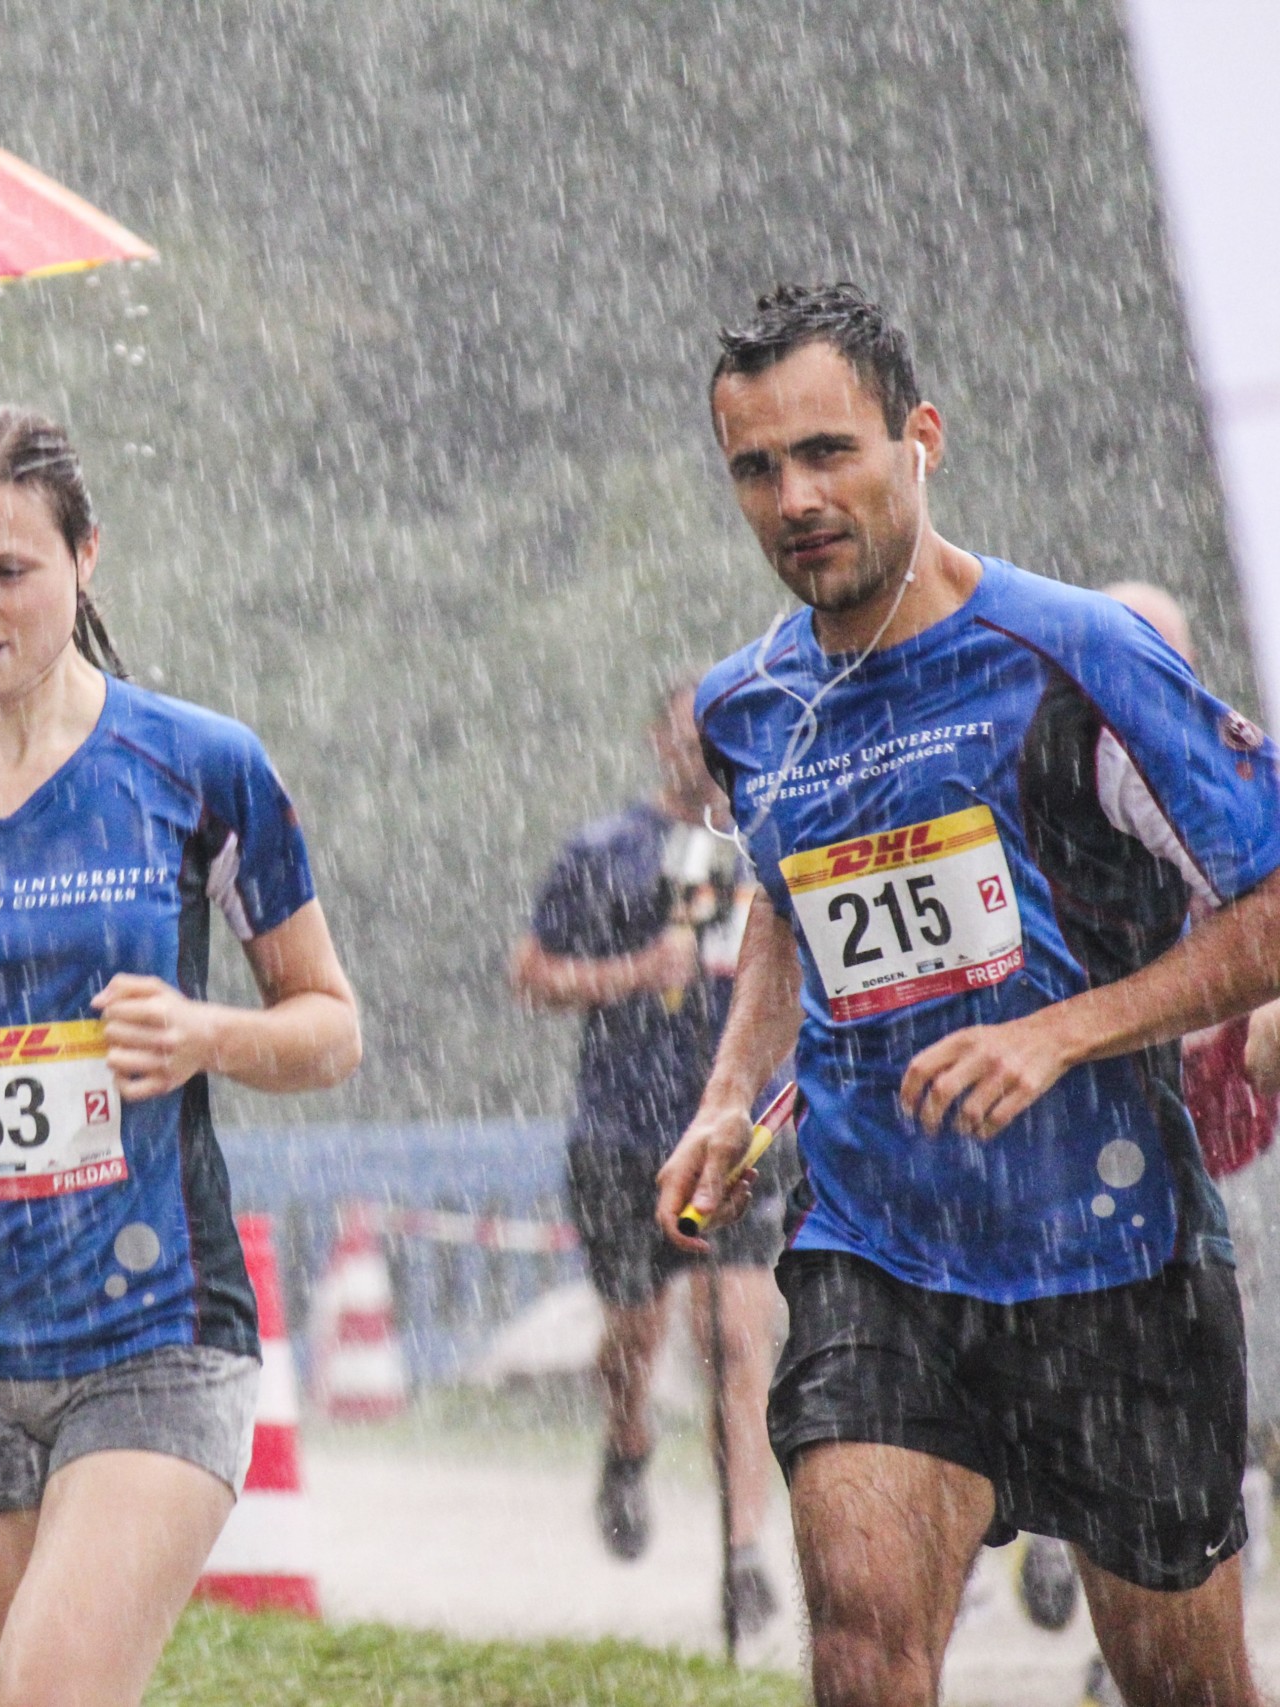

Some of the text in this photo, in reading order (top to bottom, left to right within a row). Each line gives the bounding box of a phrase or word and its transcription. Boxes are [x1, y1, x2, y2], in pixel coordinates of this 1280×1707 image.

[860, 721, 993, 761] UNIVERSITET
[753, 743, 956, 807] UNVERSITY OF COPENHAGEN
[827, 824, 946, 878] DHL
[14, 867, 168, 895] UNIVERSITET
[982, 879, 1005, 910] 2
[13, 887, 136, 909] COPENHAGEN
[828, 874, 952, 968] 215
[87, 1093, 108, 1123] 2
[53, 1161, 122, 1192] FREDAG
